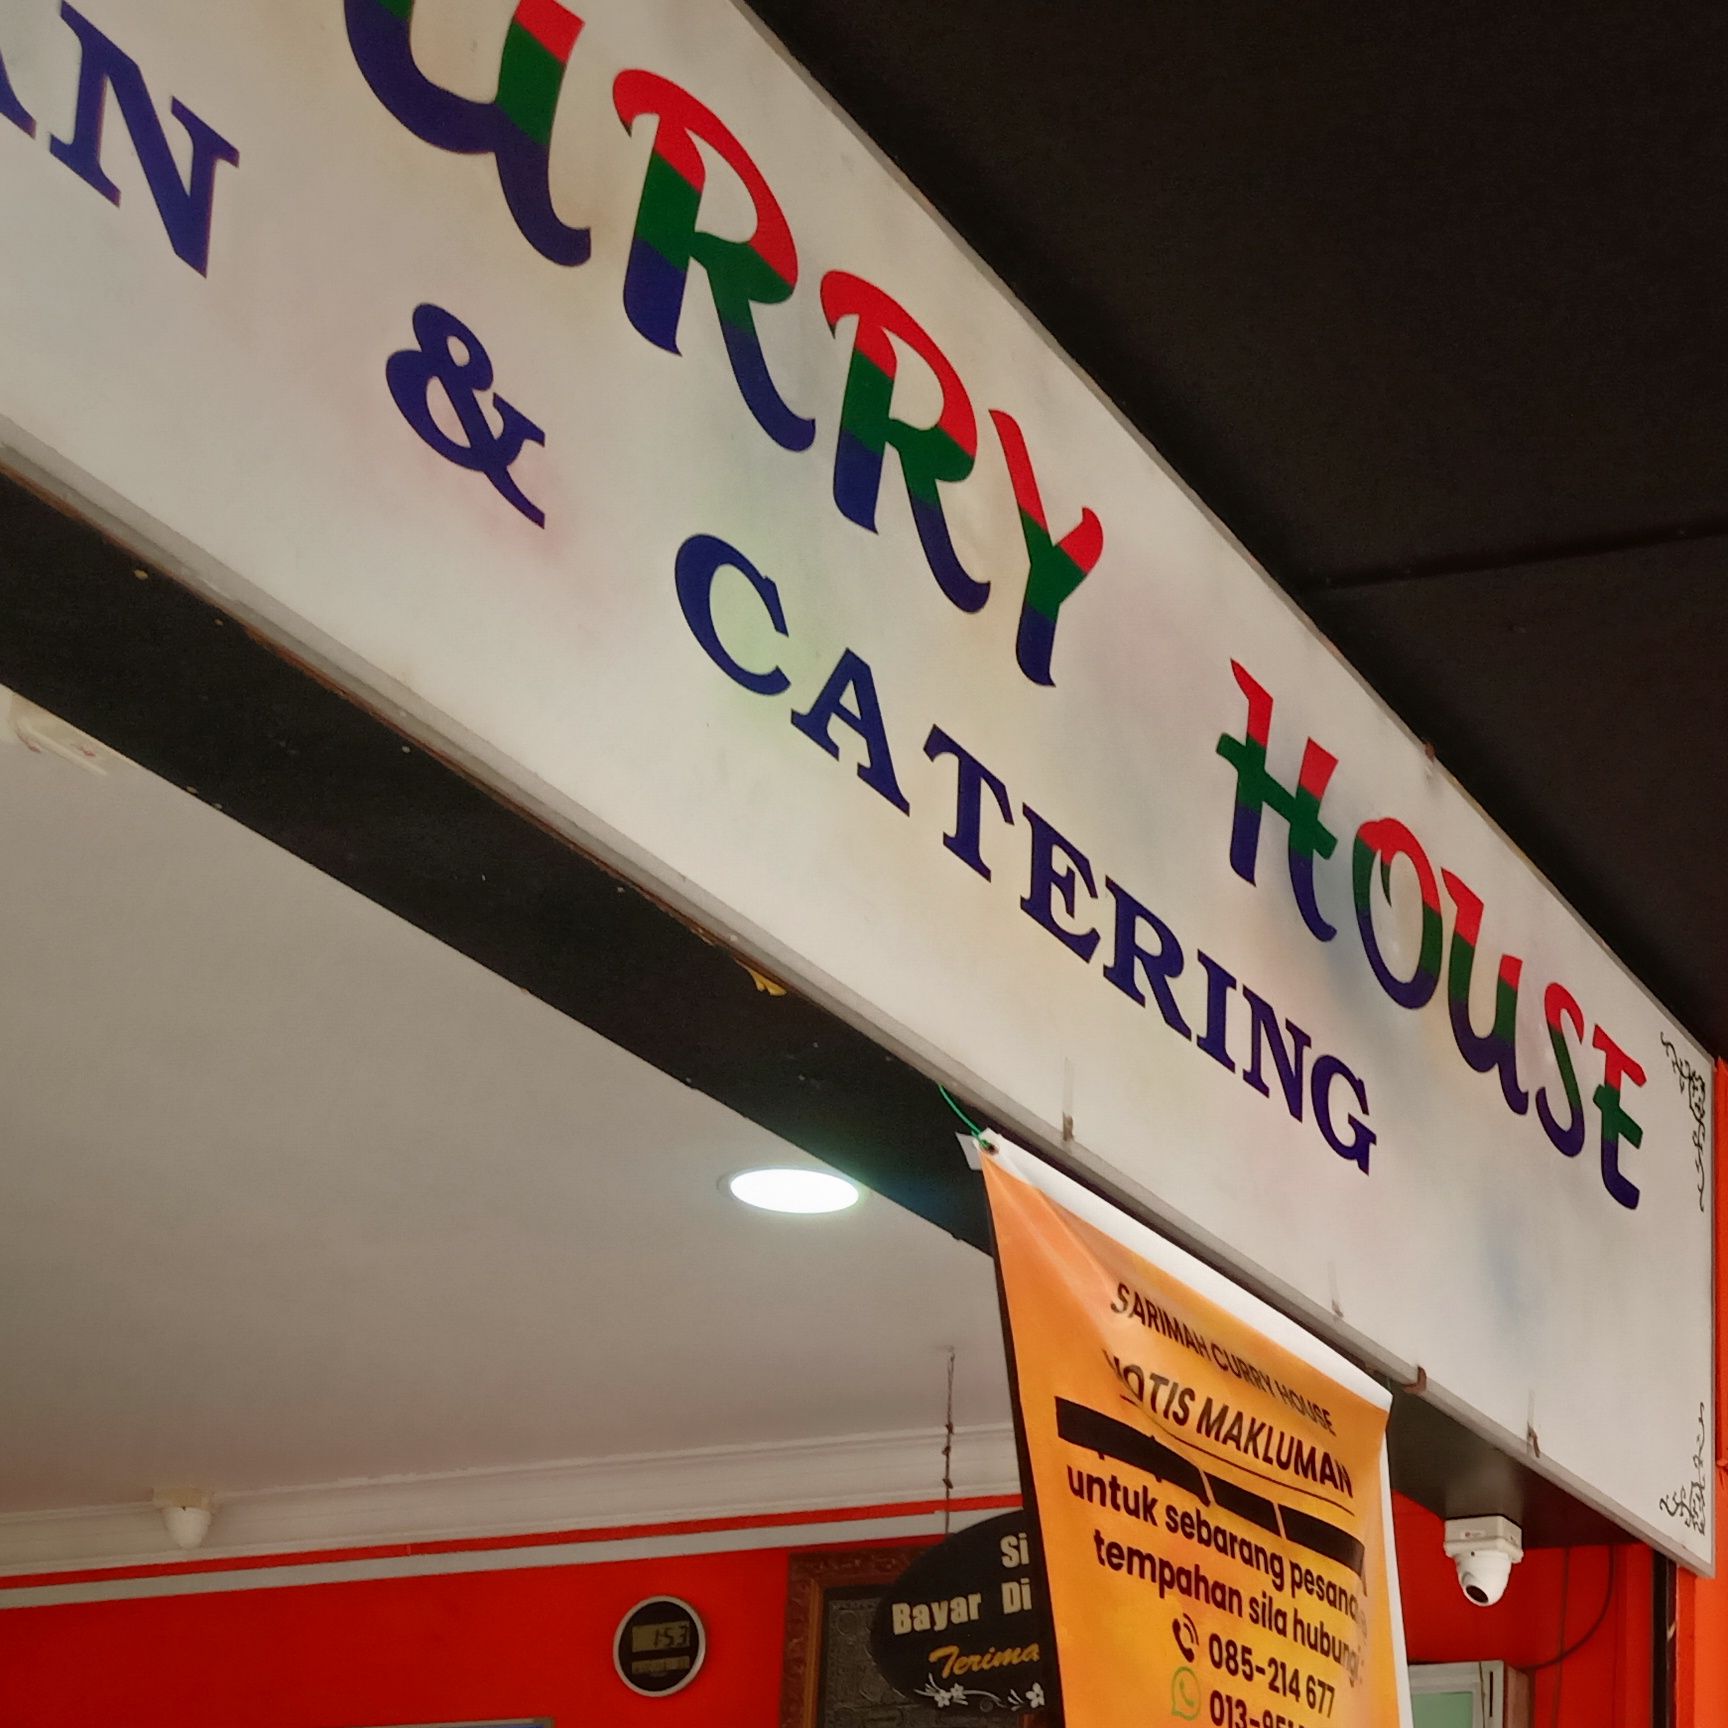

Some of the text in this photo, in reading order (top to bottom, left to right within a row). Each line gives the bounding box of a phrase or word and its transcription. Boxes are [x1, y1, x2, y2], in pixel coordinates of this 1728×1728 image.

[385, 303, 545, 530] &
[673, 533, 1378, 1176] CATERING
[1215, 658, 1647, 1209] HOUSE
[1110, 1283, 1337, 1437] SARIMAH CURRY HOUSE
[1196, 1396, 1354, 1498] MAKLUMAN
[1068, 1464, 1157, 1527] untuk
[1165, 1504, 1286, 1589] sebarang
[892, 1577, 1033, 1635] Bayar Di
[1094, 1530, 1243, 1618] tempahan
[1249, 1596, 1288, 1638] sila
[928, 1642, 1041, 1679] Terima
[1209, 1633, 1336, 1719] 085-214 677
